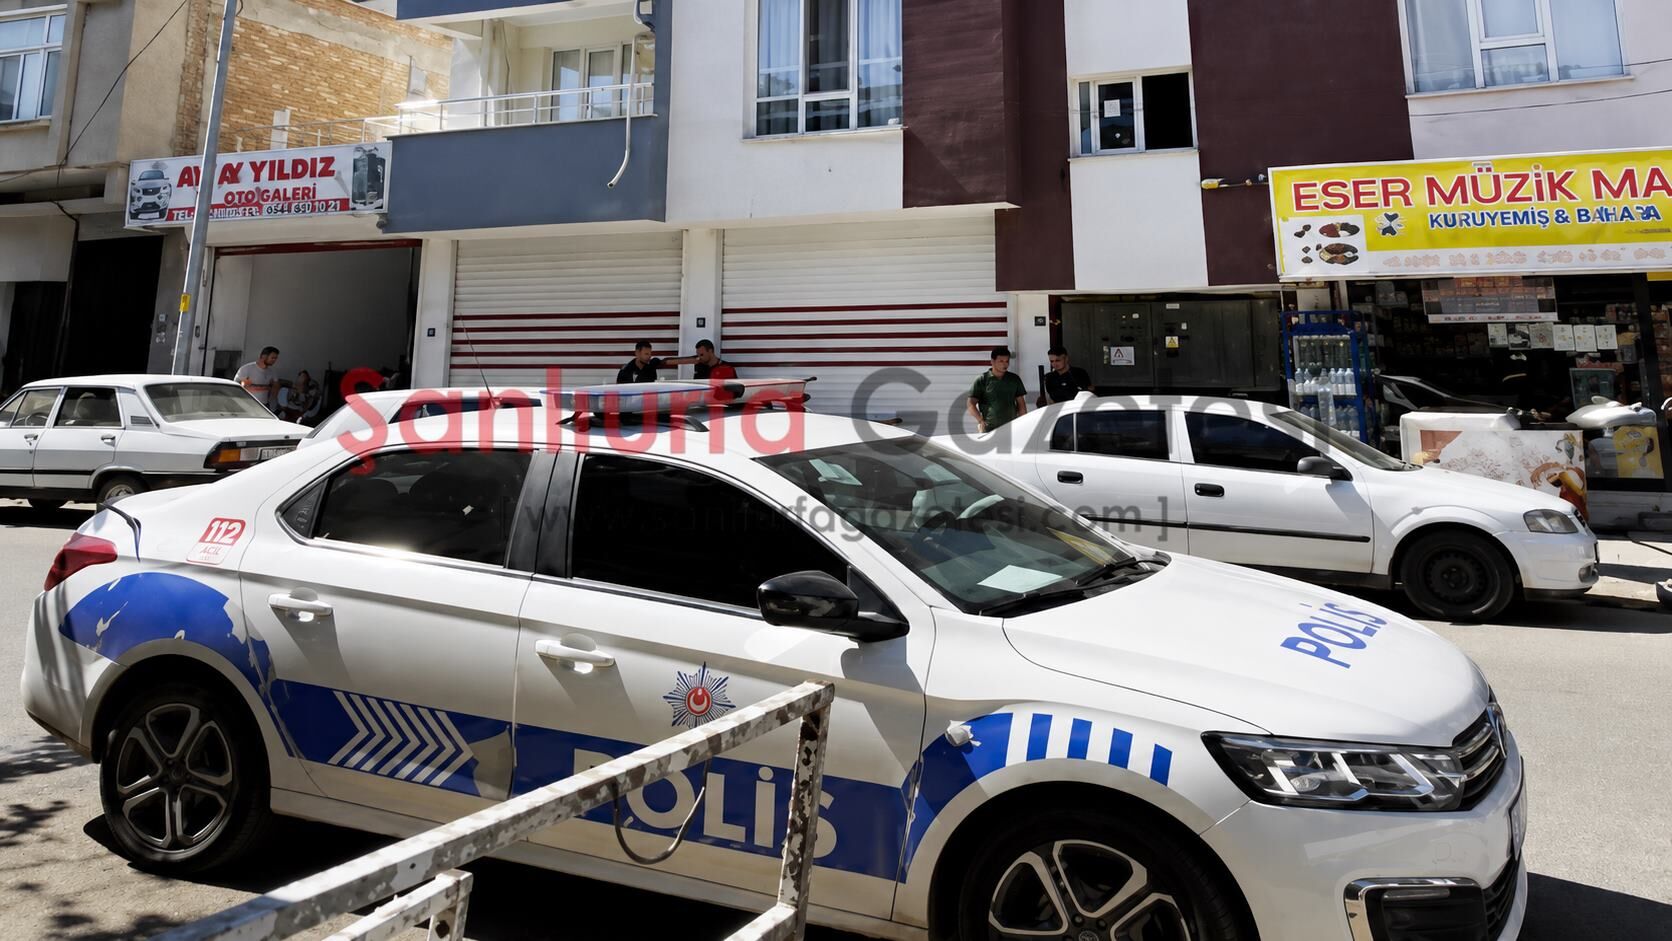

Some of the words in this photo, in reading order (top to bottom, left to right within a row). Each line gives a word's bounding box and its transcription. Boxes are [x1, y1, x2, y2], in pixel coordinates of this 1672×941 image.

[249, 156, 336, 182] YILDIZ
[258, 183, 317, 203] GALERİ
[1292, 176, 1414, 212] ESER
[1426, 165, 1578, 207] MÜZİK
[1429, 207, 1550, 229] KURUYEMİŞ
[1555, 209, 1570, 224] &
[204, 520, 242, 544] 112
[1280, 603, 1387, 669] POLİS
